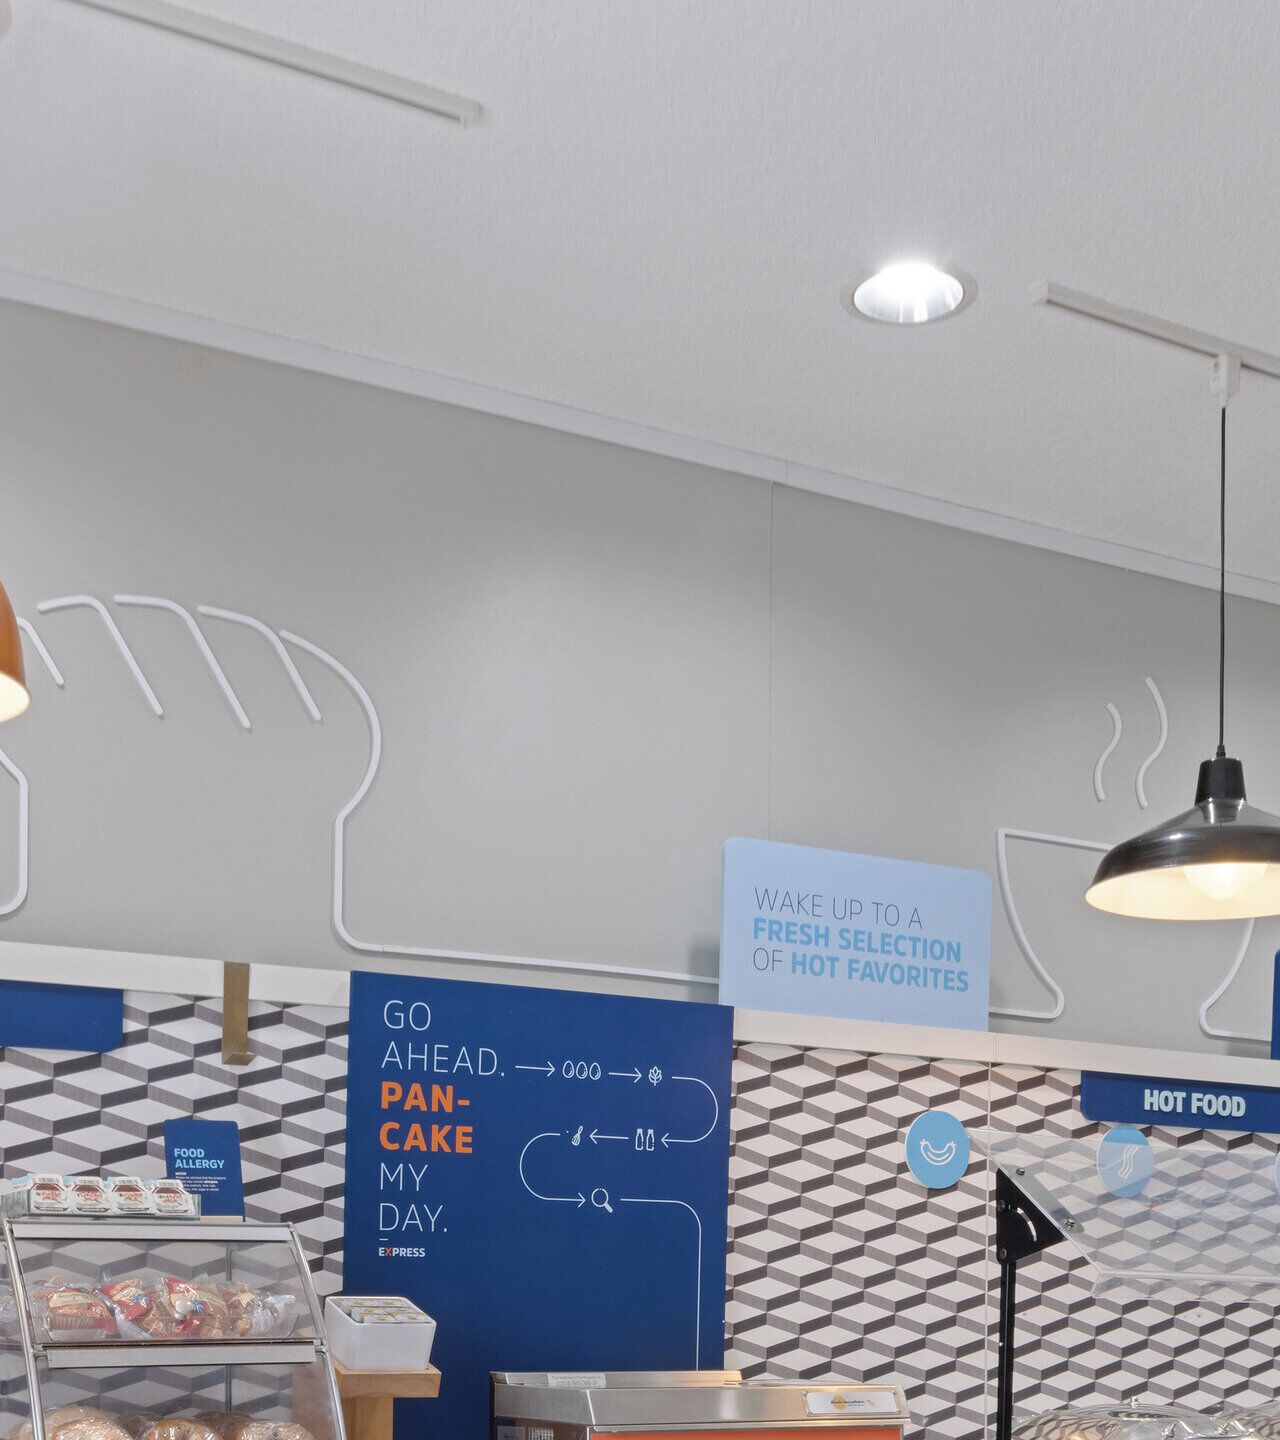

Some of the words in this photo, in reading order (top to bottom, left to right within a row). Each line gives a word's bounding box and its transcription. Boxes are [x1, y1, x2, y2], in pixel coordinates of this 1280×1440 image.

[754, 886, 824, 918] WAKE
[832, 895, 863, 922] UP
[871, 901, 901, 928] TO
[907, 906, 923, 931] A
[752, 916, 830, 949] FRESH
[838, 927, 962, 964] SELECTION
[752, 947, 784, 973] OF
[790, 951, 840, 978] HOT
[847, 958, 970, 994] FAVORITES
[382, 999, 432, 1032] GO
[381, 1040, 506, 1078] AHEAD.
[381, 1080, 471, 1114] PAN-
[1143, 1088, 1187, 1114] HOT
[1191, 1091, 1247, 1119] FOOD
[173, 1147, 205, 1158] FOOD
[378, 1121, 474, 1155] CAKE
[174, 1159, 225, 1169] ALLERGY
[379, 1161, 429, 1192] MY
[378, 1202, 448, 1234] DAY.
[378, 1246, 426, 1259] EXPRESS
